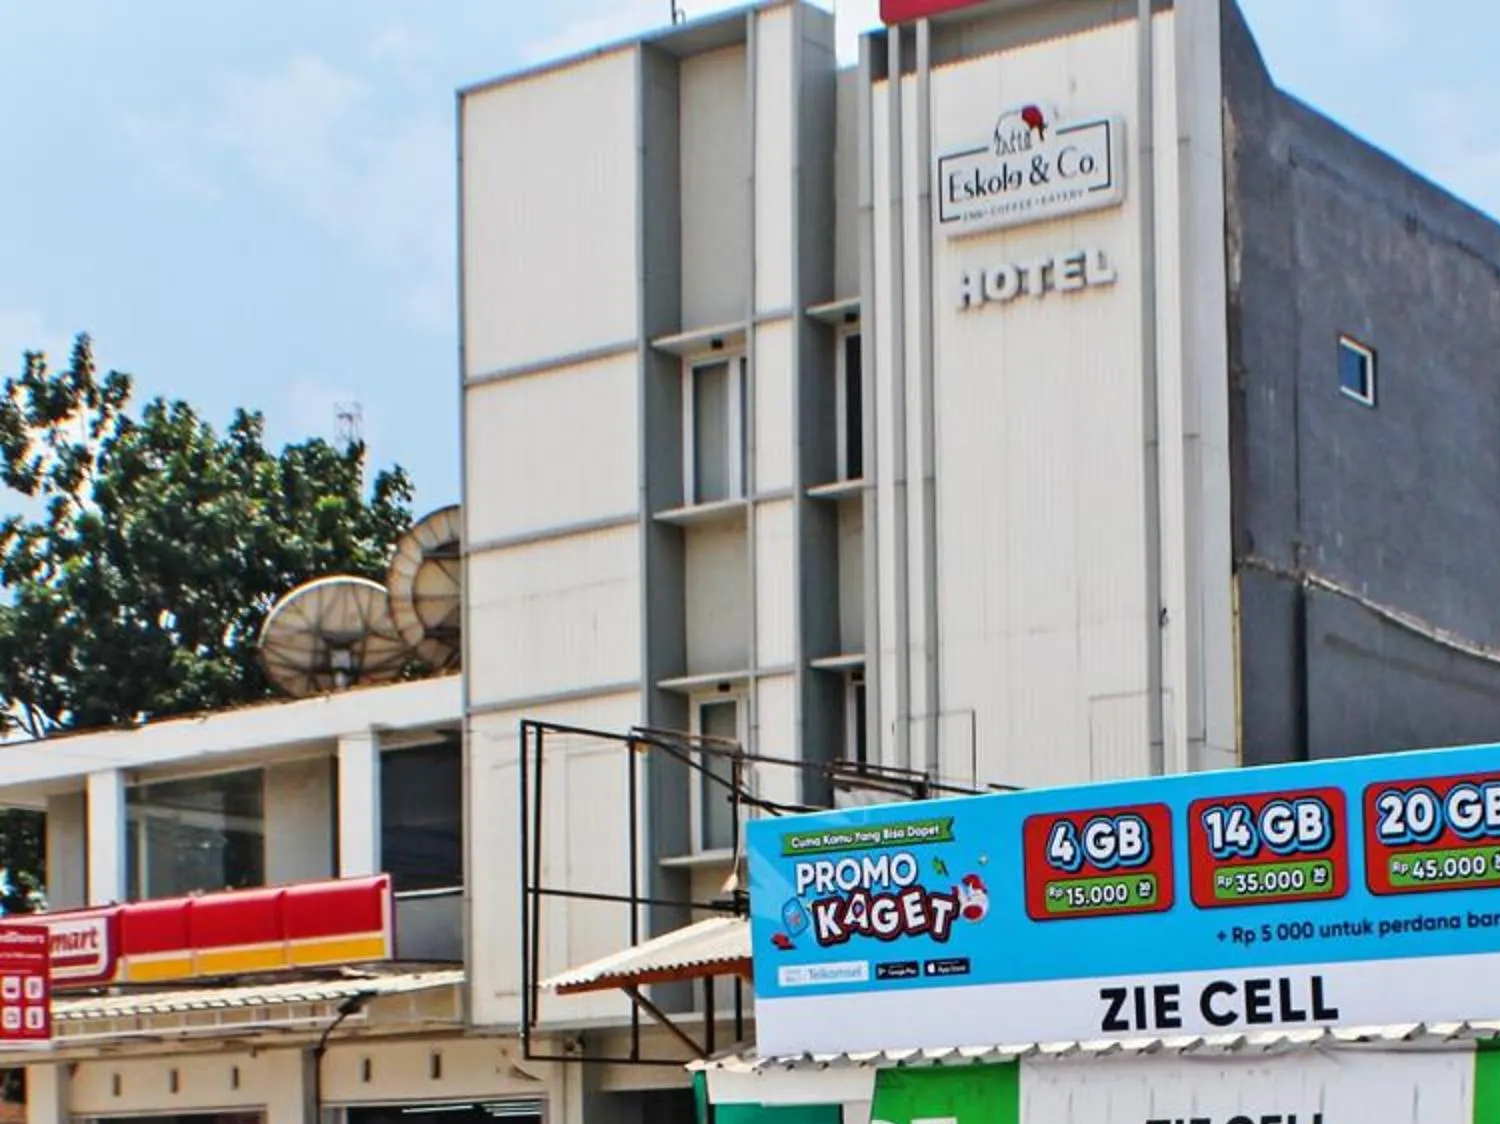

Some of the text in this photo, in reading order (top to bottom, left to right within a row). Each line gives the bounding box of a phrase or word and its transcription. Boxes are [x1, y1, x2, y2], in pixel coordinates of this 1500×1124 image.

[1029, 154, 1050, 186] &
[959, 249, 1117, 311] HOTEL
[1204, 801, 1324, 849] 14 GB
[1380, 791, 1434, 836] 20
[791, 836, 821, 848] Cuma
[823, 834, 852, 845] Kamu
[855, 831, 881, 843] Yang
[883, 827, 905, 839] Bisa
[1050, 818, 1147, 862] 4 GB
[796, 852, 918, 894] PROMO
[1217, 875, 1232, 888] Rp
[1236, 869, 1304, 892] 35.000
[1392, 861, 1408, 875] Rp
[1413, 854, 1485, 879] 45.000
[816, 890, 954, 940] KAGET
[1050, 886, 1064, 900] Rp
[1065, 882, 1127, 906] 15.000
[1231, 925, 1256, 948] Rp
[1319, 916, 1374, 939] untuk
[1378, 913, 1461, 939] perdana
[1100, 975, 1339, 1032] ZIE CELL
